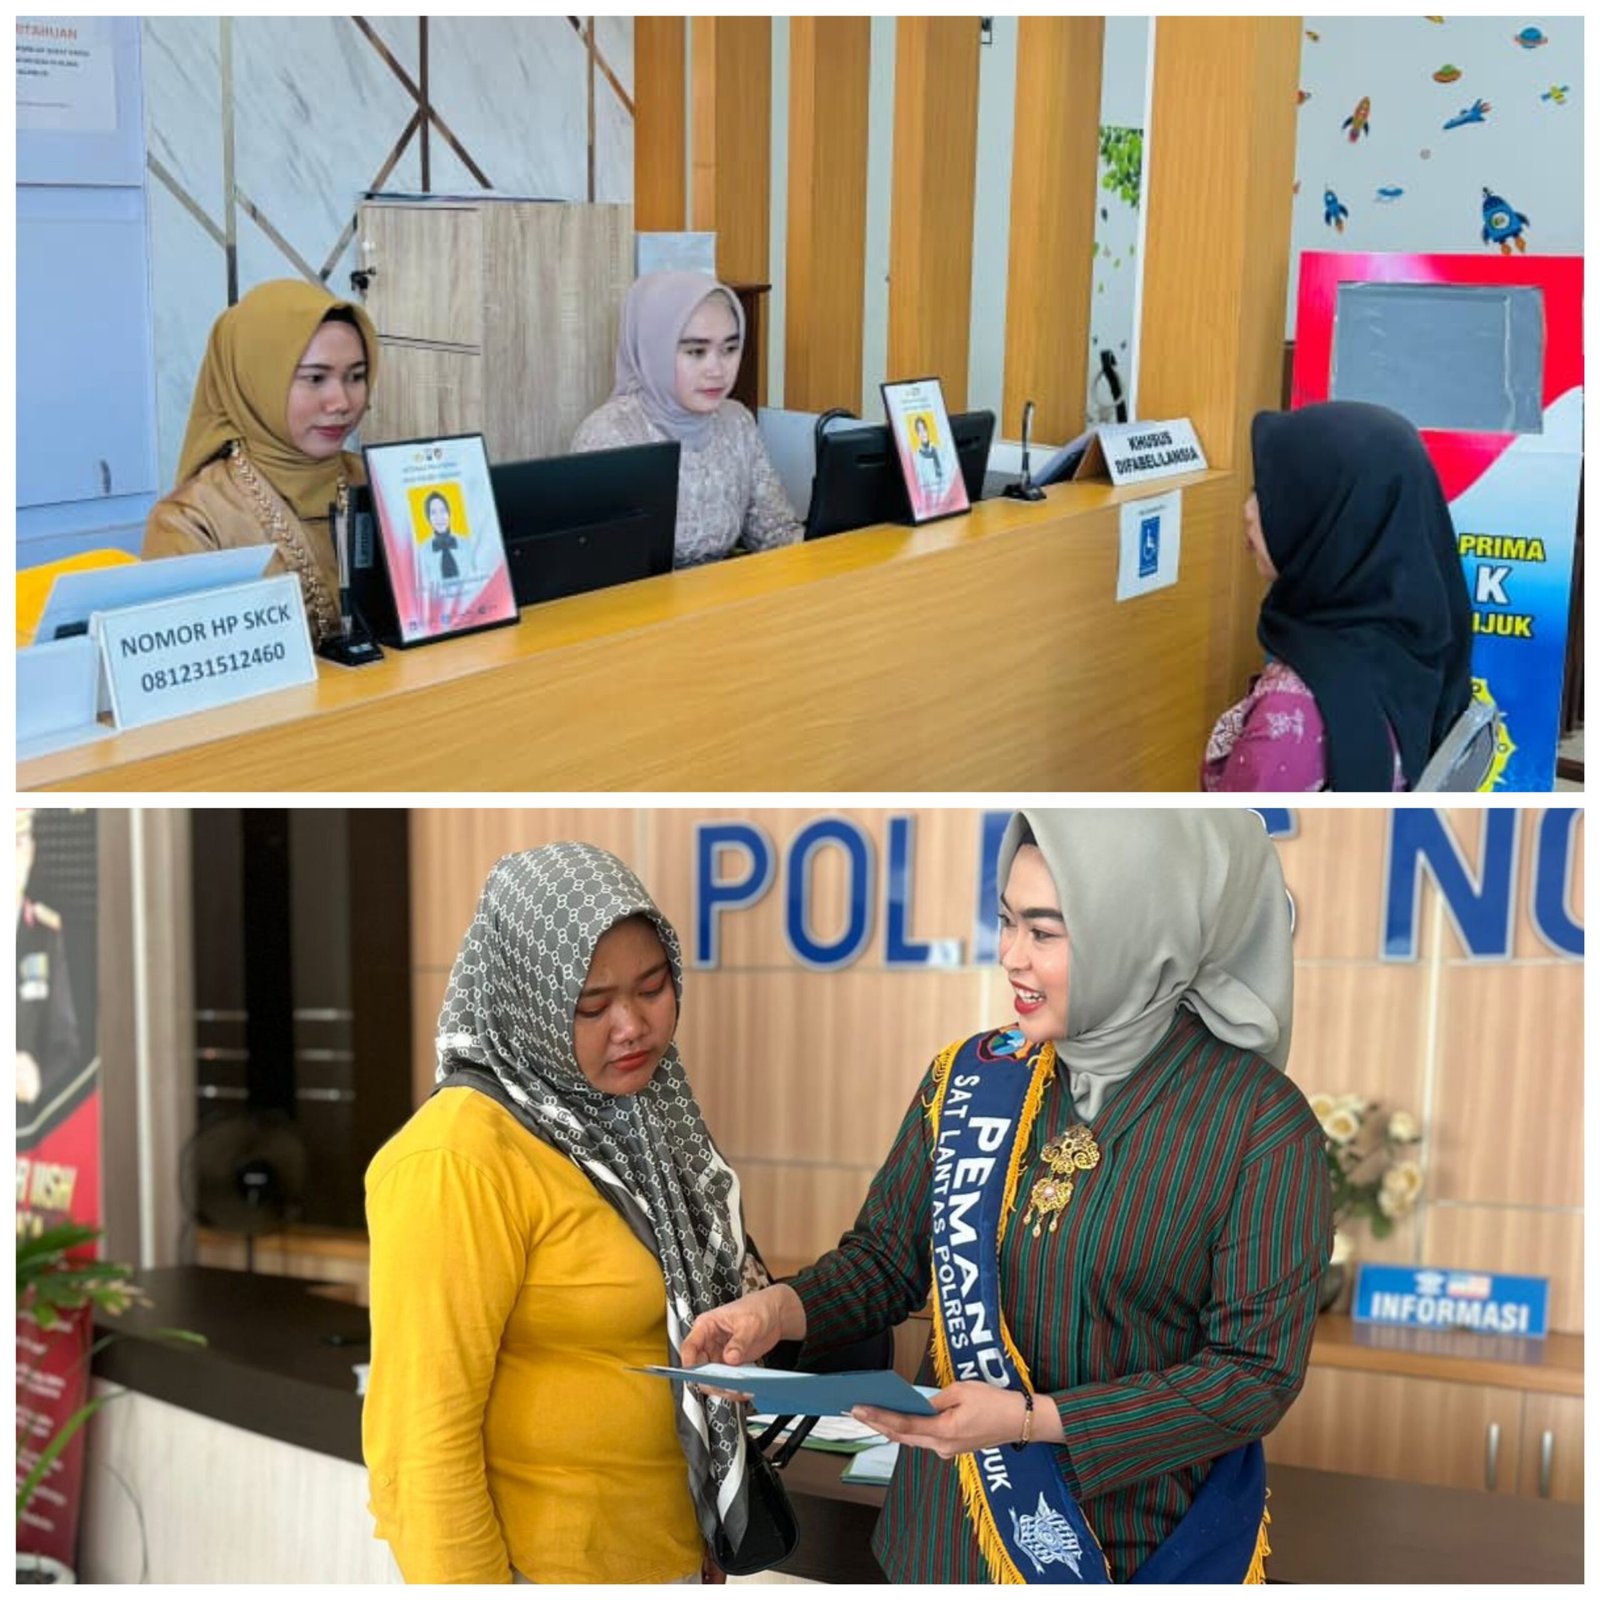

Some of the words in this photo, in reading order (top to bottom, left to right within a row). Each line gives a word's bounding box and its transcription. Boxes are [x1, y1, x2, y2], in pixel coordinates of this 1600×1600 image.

[1114, 446, 1200, 475] DIFABEL/LANSIA
[1127, 430, 1173, 452] KHUSUS
[1458, 533, 1547, 562] PRIMA
[120, 622, 207, 658] NOMOR
[210, 615, 239, 638] HP
[243, 604, 291, 630] SKCK
[140, 641, 286, 692] 081231512460
[943, 1074, 981, 1119] SAT
[932, 1129, 962, 1234] LANTAS
[947, 1116, 1012, 1389] PEMAND
[935, 1245, 969, 1350] POLRES
[1370, 1290, 1530, 1333] INFORMASI
